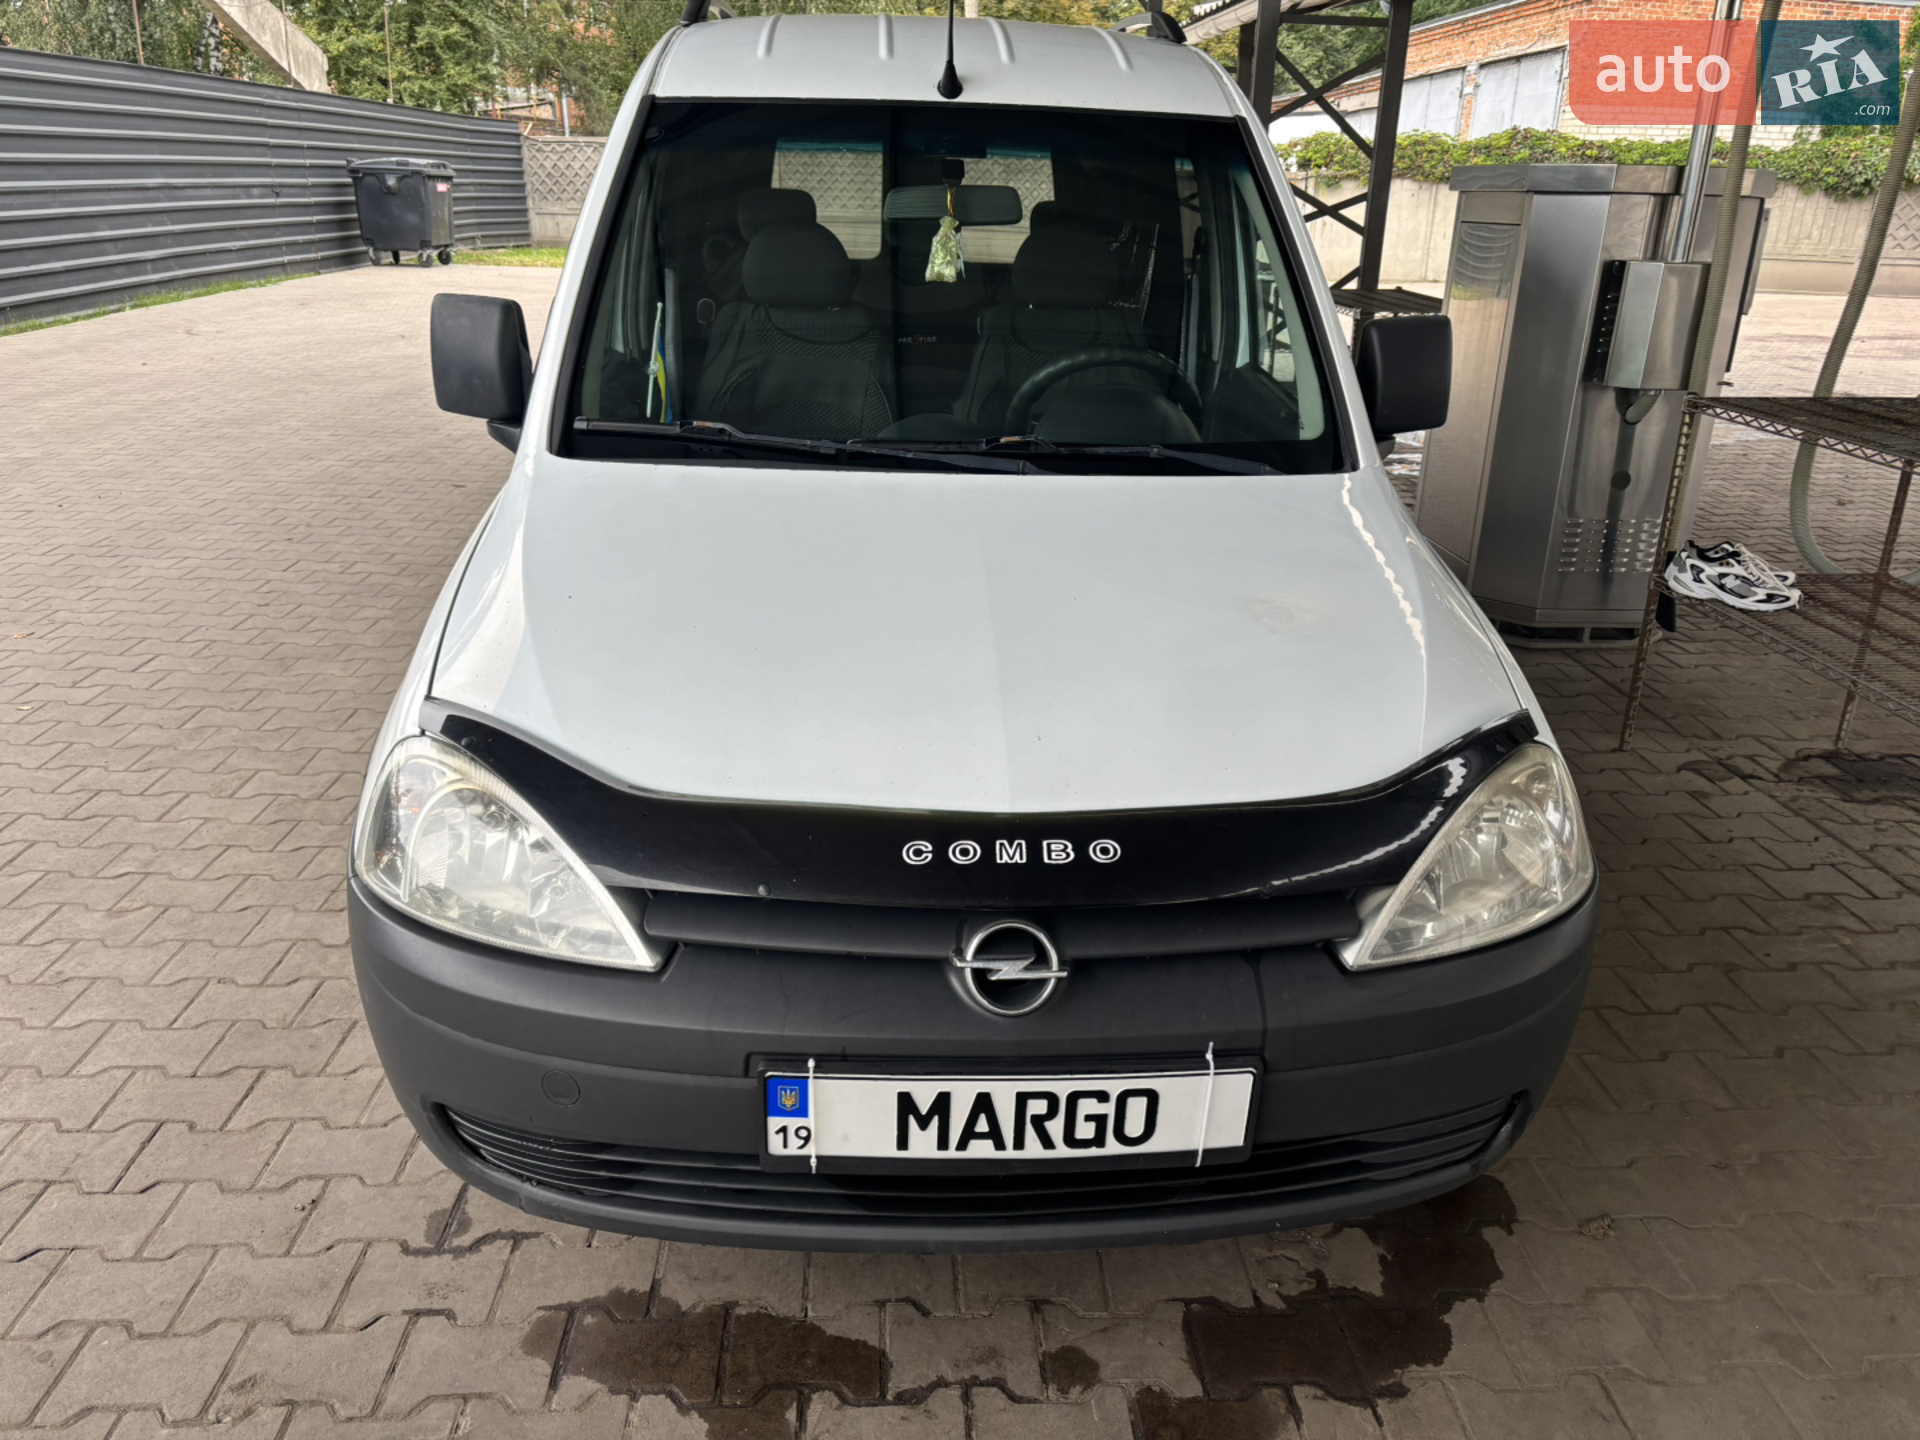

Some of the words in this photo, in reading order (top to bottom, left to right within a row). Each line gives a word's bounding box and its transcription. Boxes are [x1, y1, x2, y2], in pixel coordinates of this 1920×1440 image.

[902, 839, 1121, 865] COMBO
[774, 1124, 812, 1150] 19
[896, 1087, 1159, 1152] MARGO
